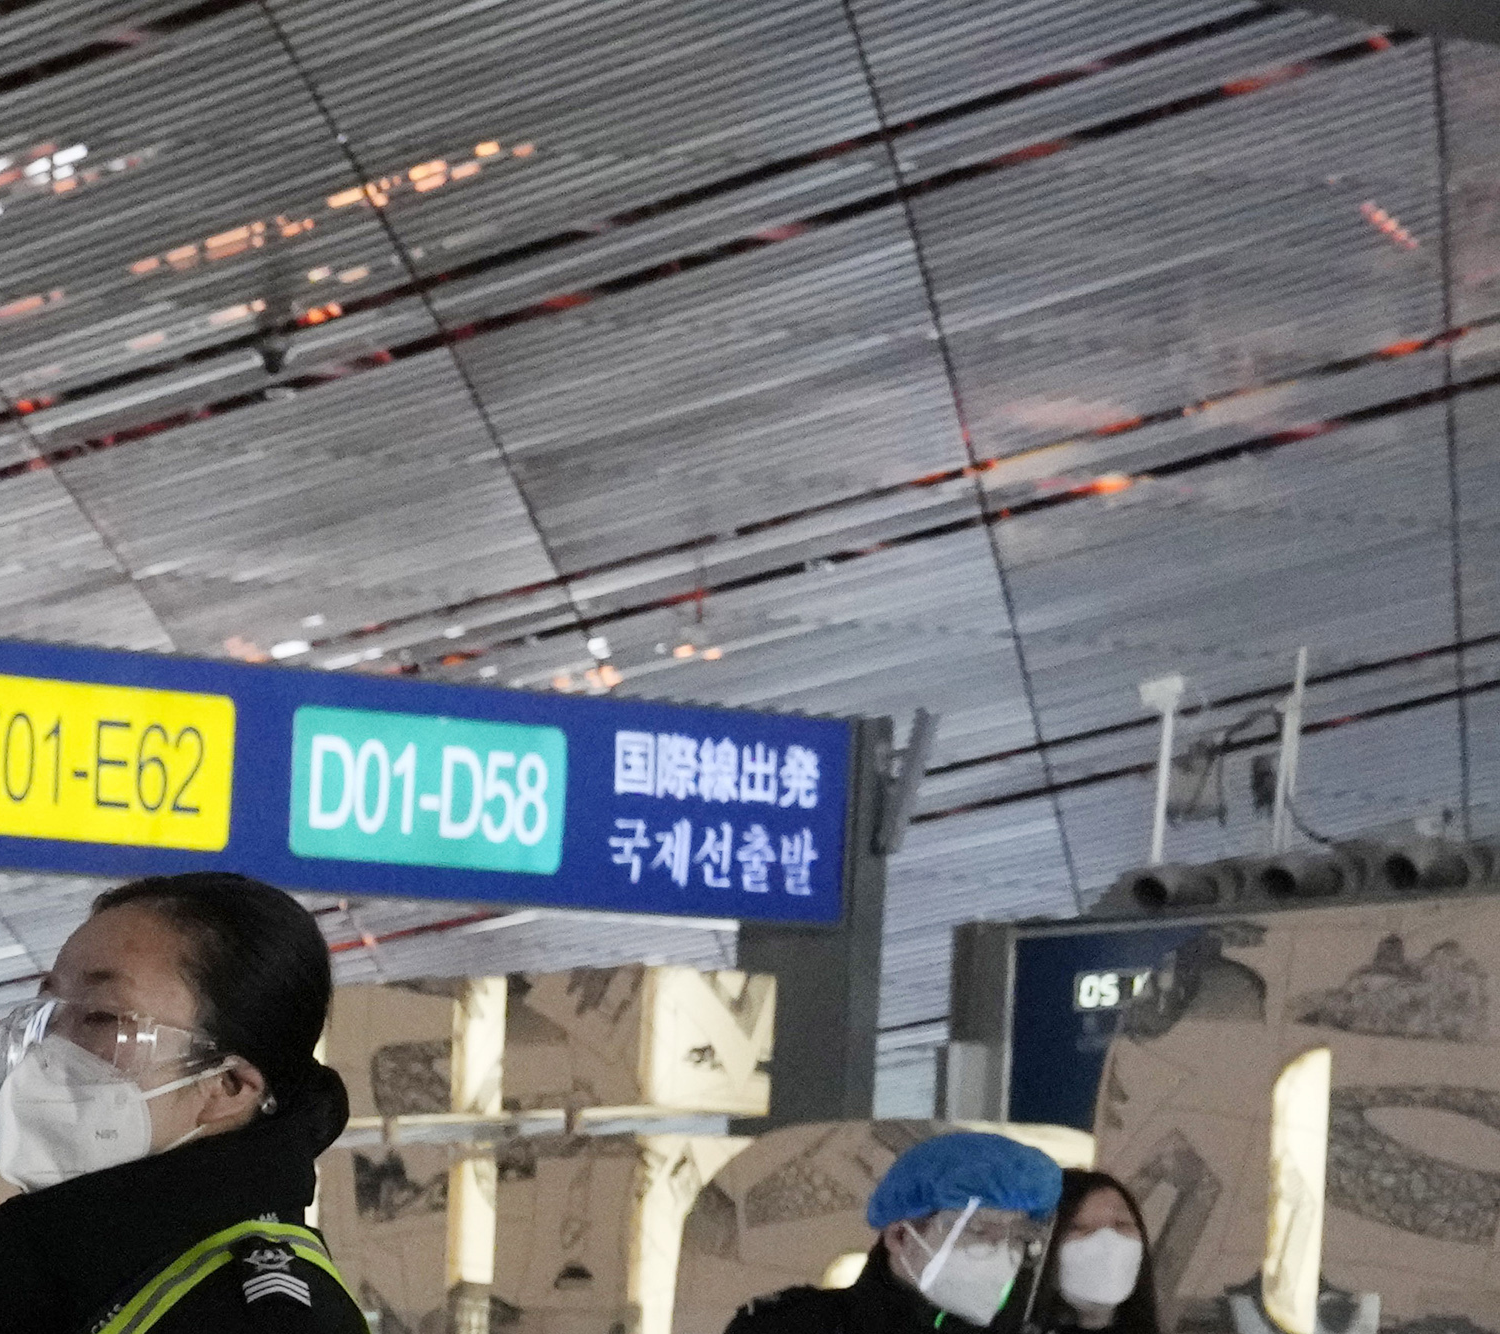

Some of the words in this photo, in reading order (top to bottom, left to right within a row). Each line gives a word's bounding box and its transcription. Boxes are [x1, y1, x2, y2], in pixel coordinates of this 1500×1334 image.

[310, 733, 548, 846] D01-D58
[613, 729, 820, 809] 国際線出発
[609, 817, 819, 898] 국제선출발
